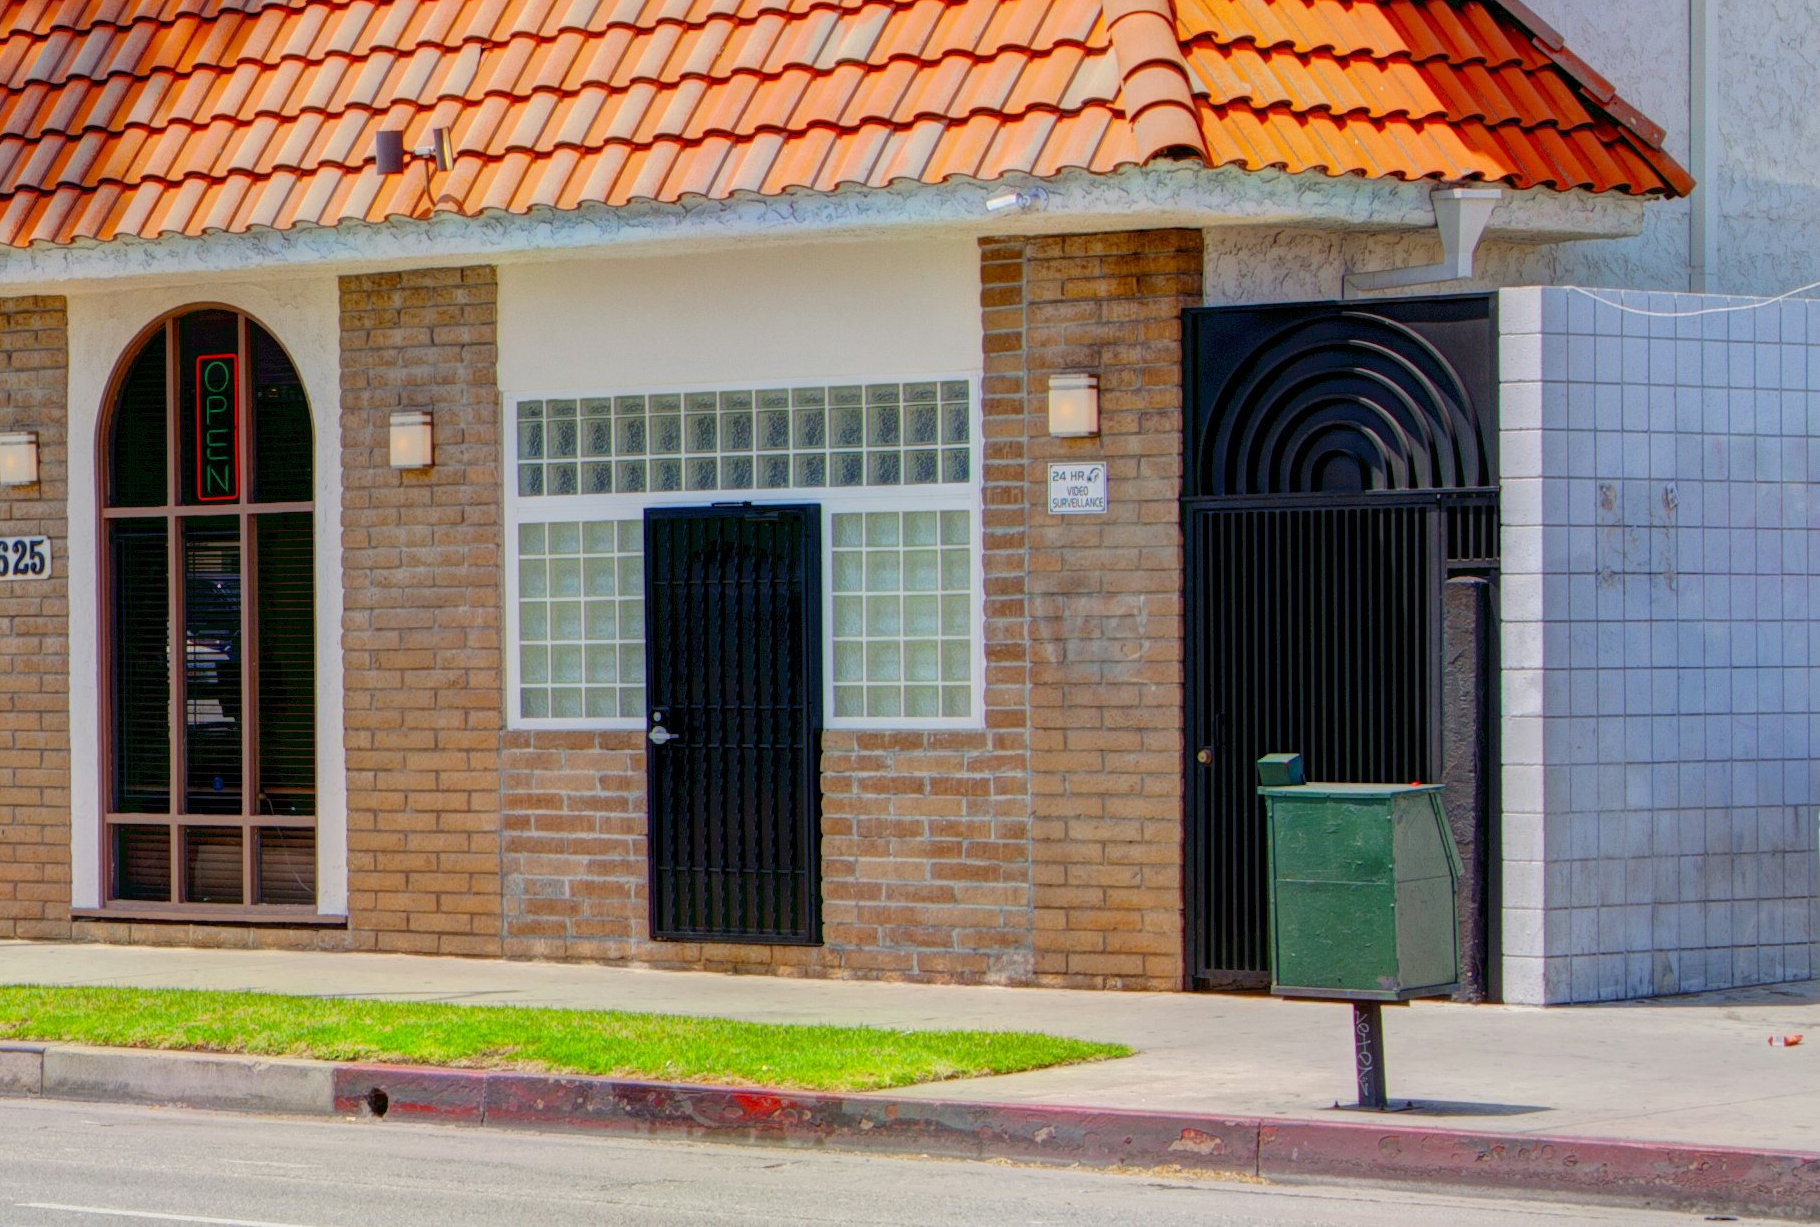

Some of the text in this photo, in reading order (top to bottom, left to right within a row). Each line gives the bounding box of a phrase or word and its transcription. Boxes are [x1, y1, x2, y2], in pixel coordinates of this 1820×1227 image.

[204, 360, 229, 494] OPEN
[1052, 470, 1085, 482] 24 HR
[1067, 485, 1088, 496] VIDEO
[1052, 497, 1104, 508] SURVEILLANCE
